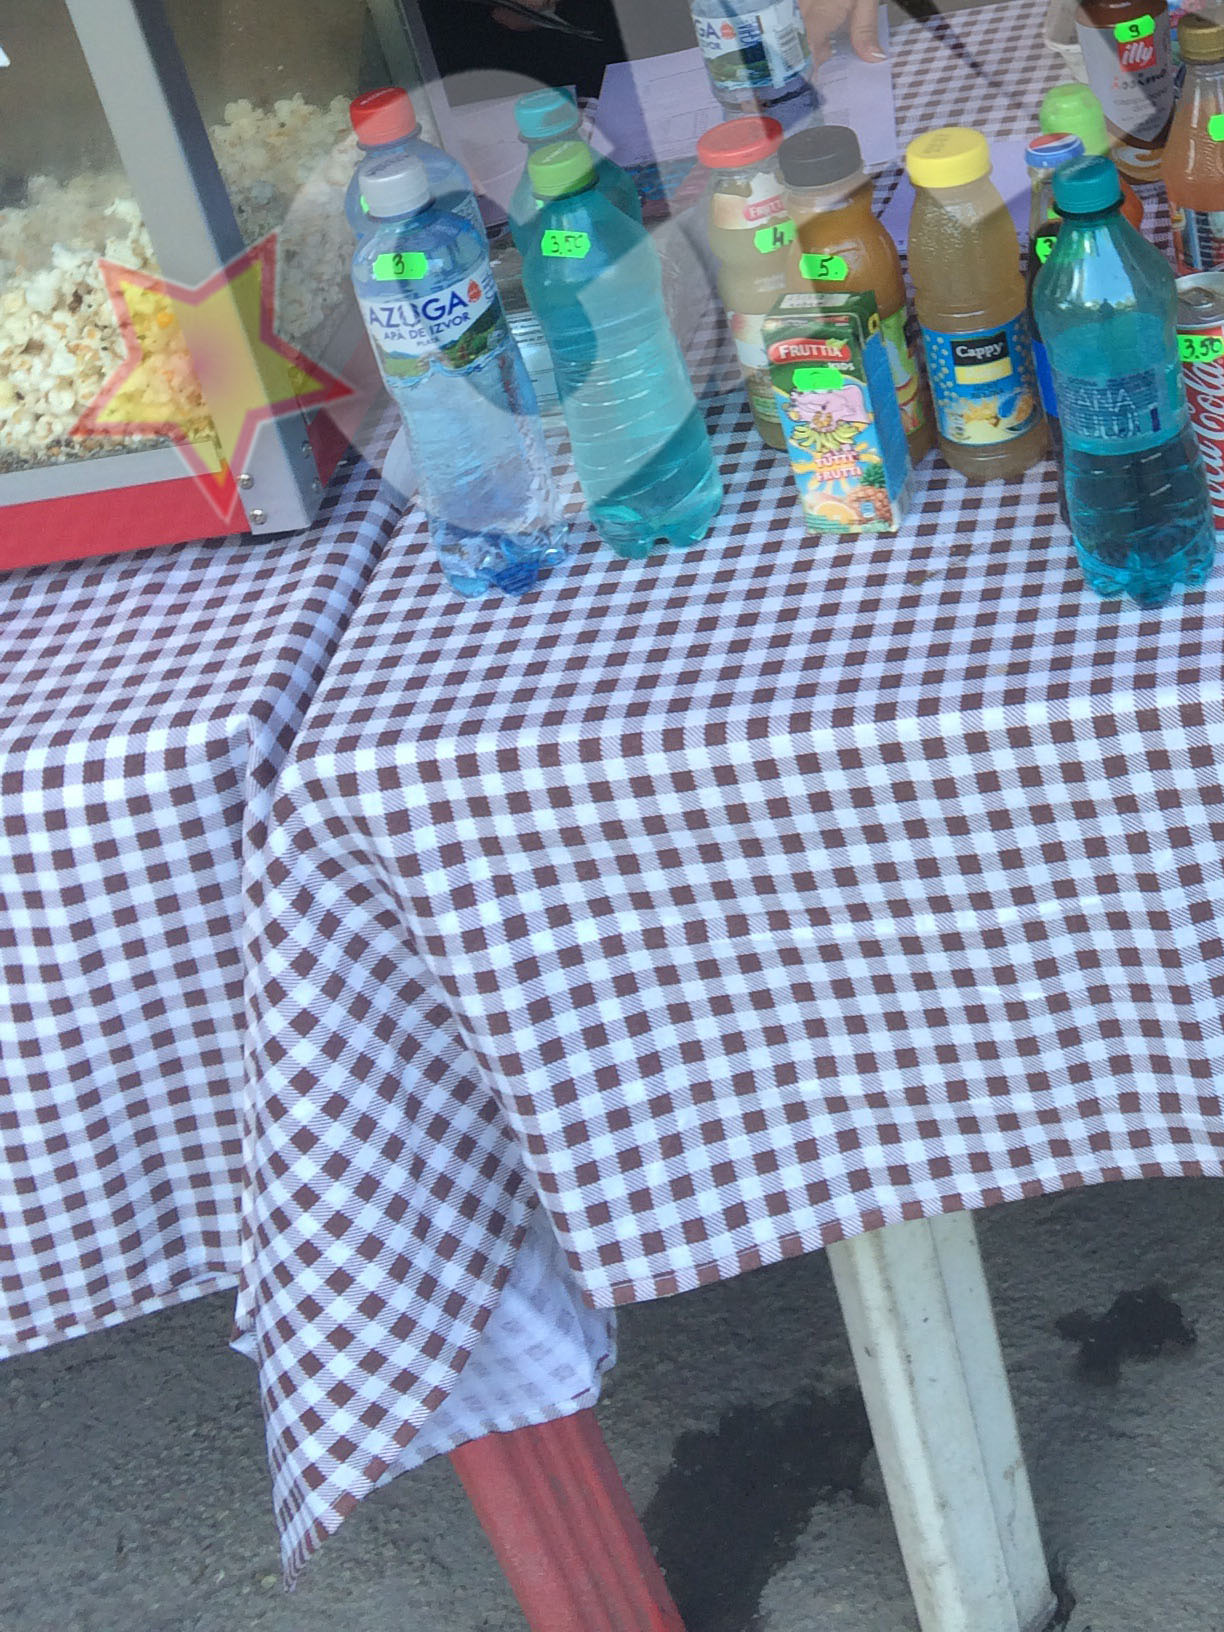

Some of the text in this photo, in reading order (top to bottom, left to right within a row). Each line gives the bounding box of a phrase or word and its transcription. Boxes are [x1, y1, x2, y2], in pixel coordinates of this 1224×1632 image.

[1121, 41, 1155, 66] illy
[369, 290, 469, 329] AZUGA
[409, 323, 428, 340] DE
[429, 311, 471, 336] IZVOR
[955, 341, 1004, 360] Cappy
[814, 467, 862, 483] FRUTTI
